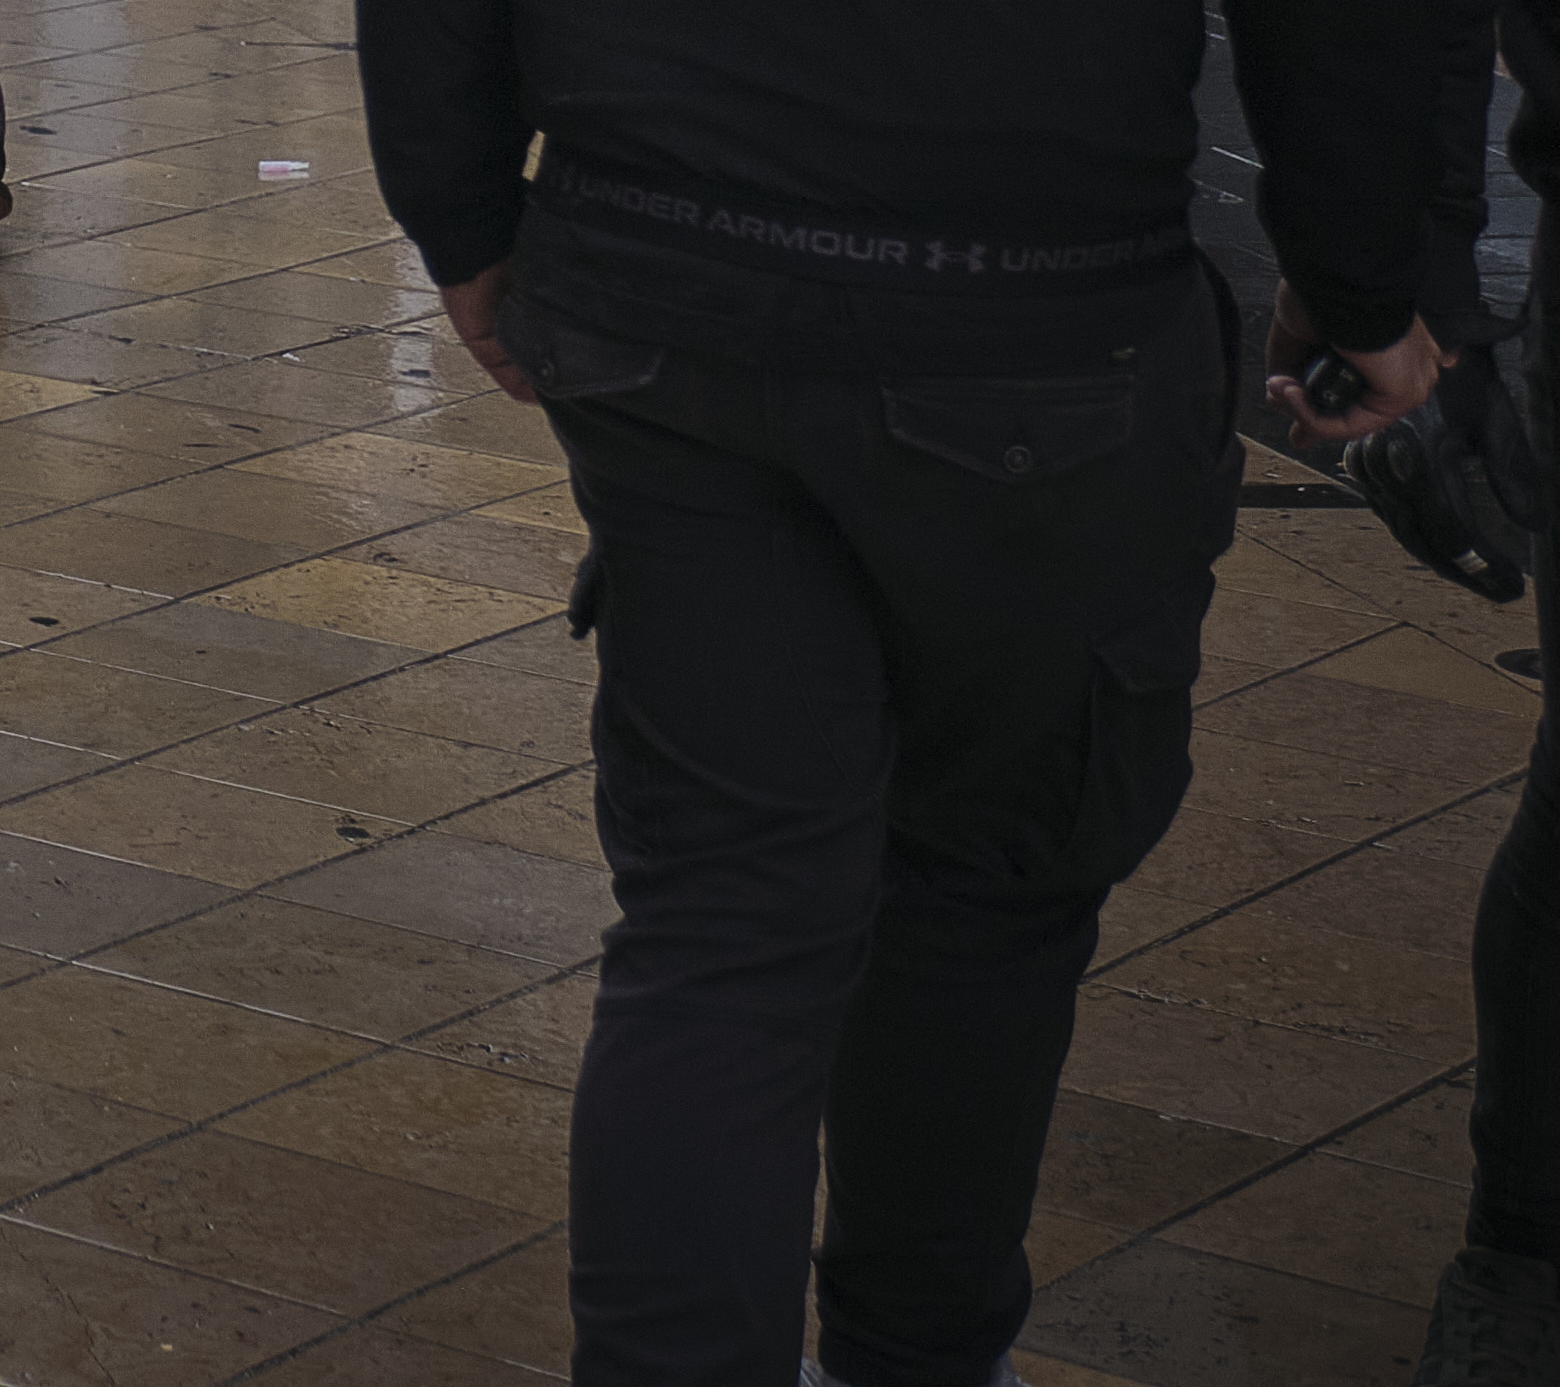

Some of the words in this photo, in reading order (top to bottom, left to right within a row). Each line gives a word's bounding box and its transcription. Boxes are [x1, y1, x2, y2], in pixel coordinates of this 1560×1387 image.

[579, 179, 703, 227] UNDER
[706, 207, 912, 266] ARMOUR
[999, 239, 1138, 274] UNDER
